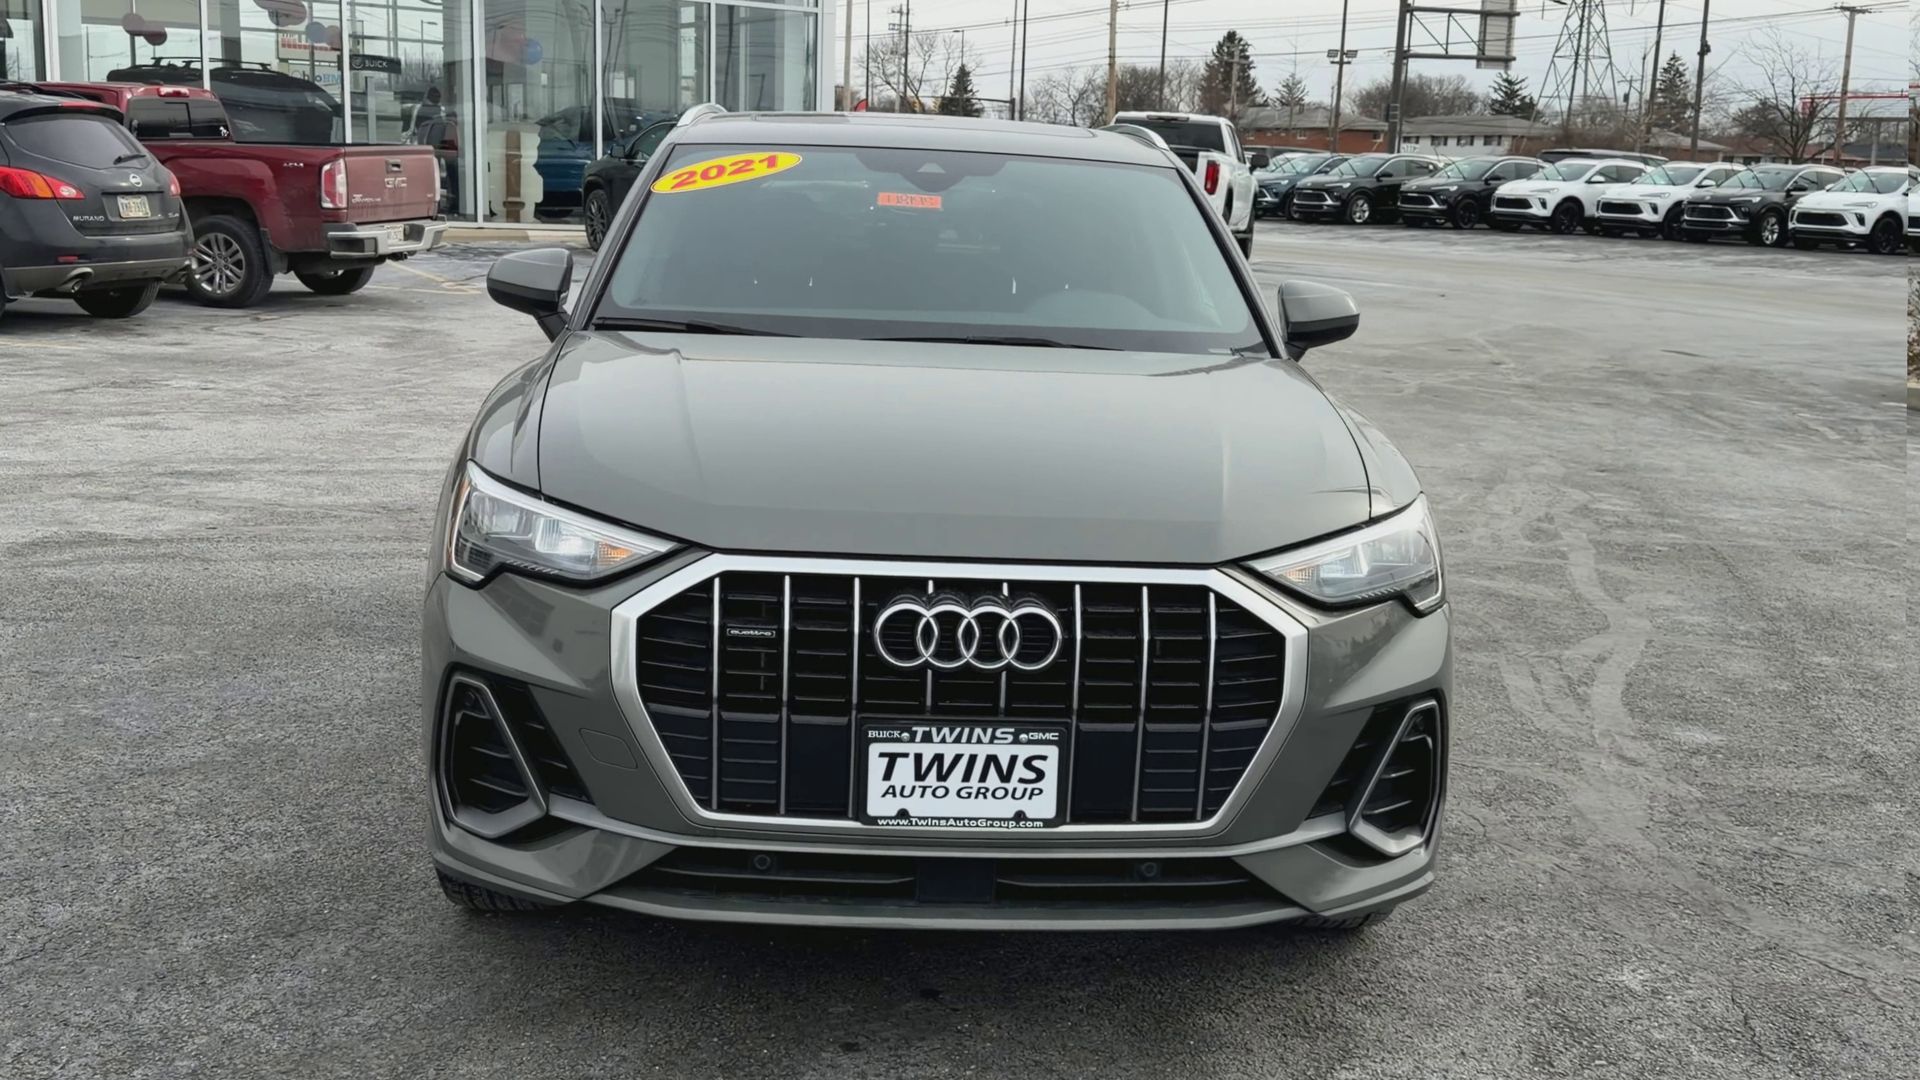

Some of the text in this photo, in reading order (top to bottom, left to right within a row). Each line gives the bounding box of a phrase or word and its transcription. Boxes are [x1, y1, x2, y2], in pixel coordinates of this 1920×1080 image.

[671, 154, 780, 190] 2021
[868, 730, 901, 739] BUICK
[912, 726, 1015, 744] TWINS
[1028, 732, 1059, 741] GMC
[878, 752, 1049, 785] TWINS
[881, 785, 1043, 801] AUTO GROUP
[877, 818, 1044, 829] www.TwinsAutoGroup.com
